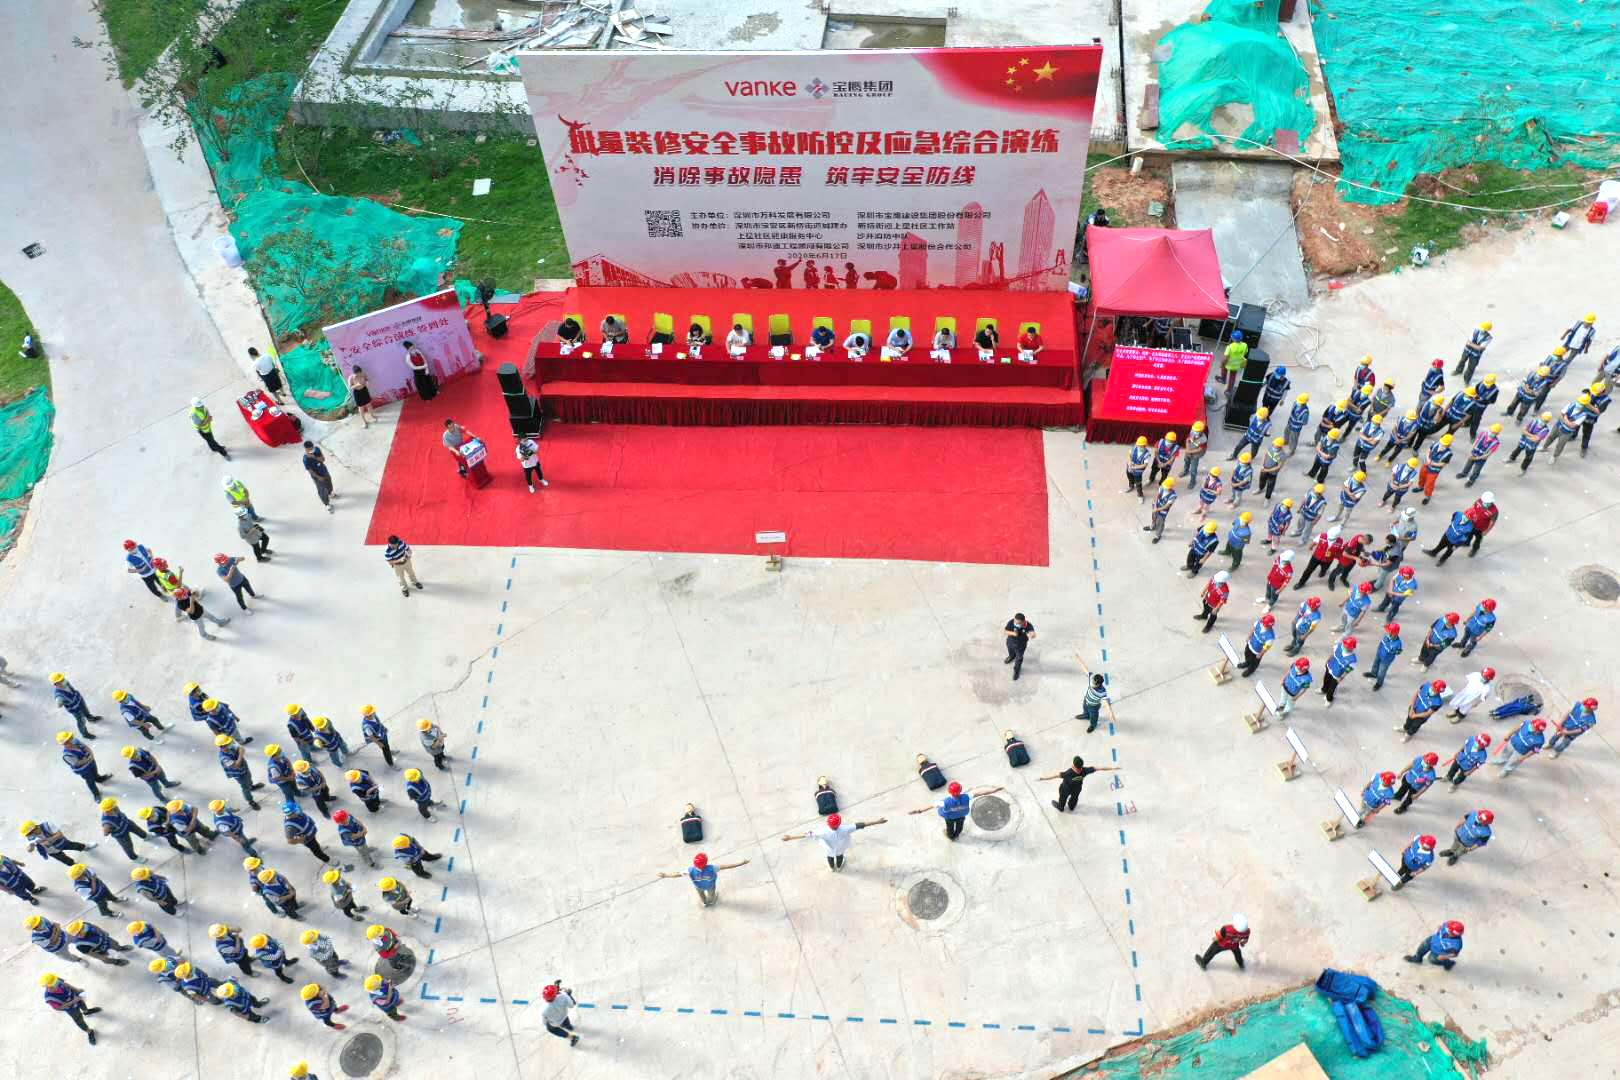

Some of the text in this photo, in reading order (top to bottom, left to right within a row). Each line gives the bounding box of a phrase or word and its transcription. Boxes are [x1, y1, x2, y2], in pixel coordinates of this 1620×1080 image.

[725, 81, 796, 97] vanke
[833, 80, 894, 92] 宝鹰集团
[653, 165, 976, 186] 消除事故隐患 筑牢安全防线
